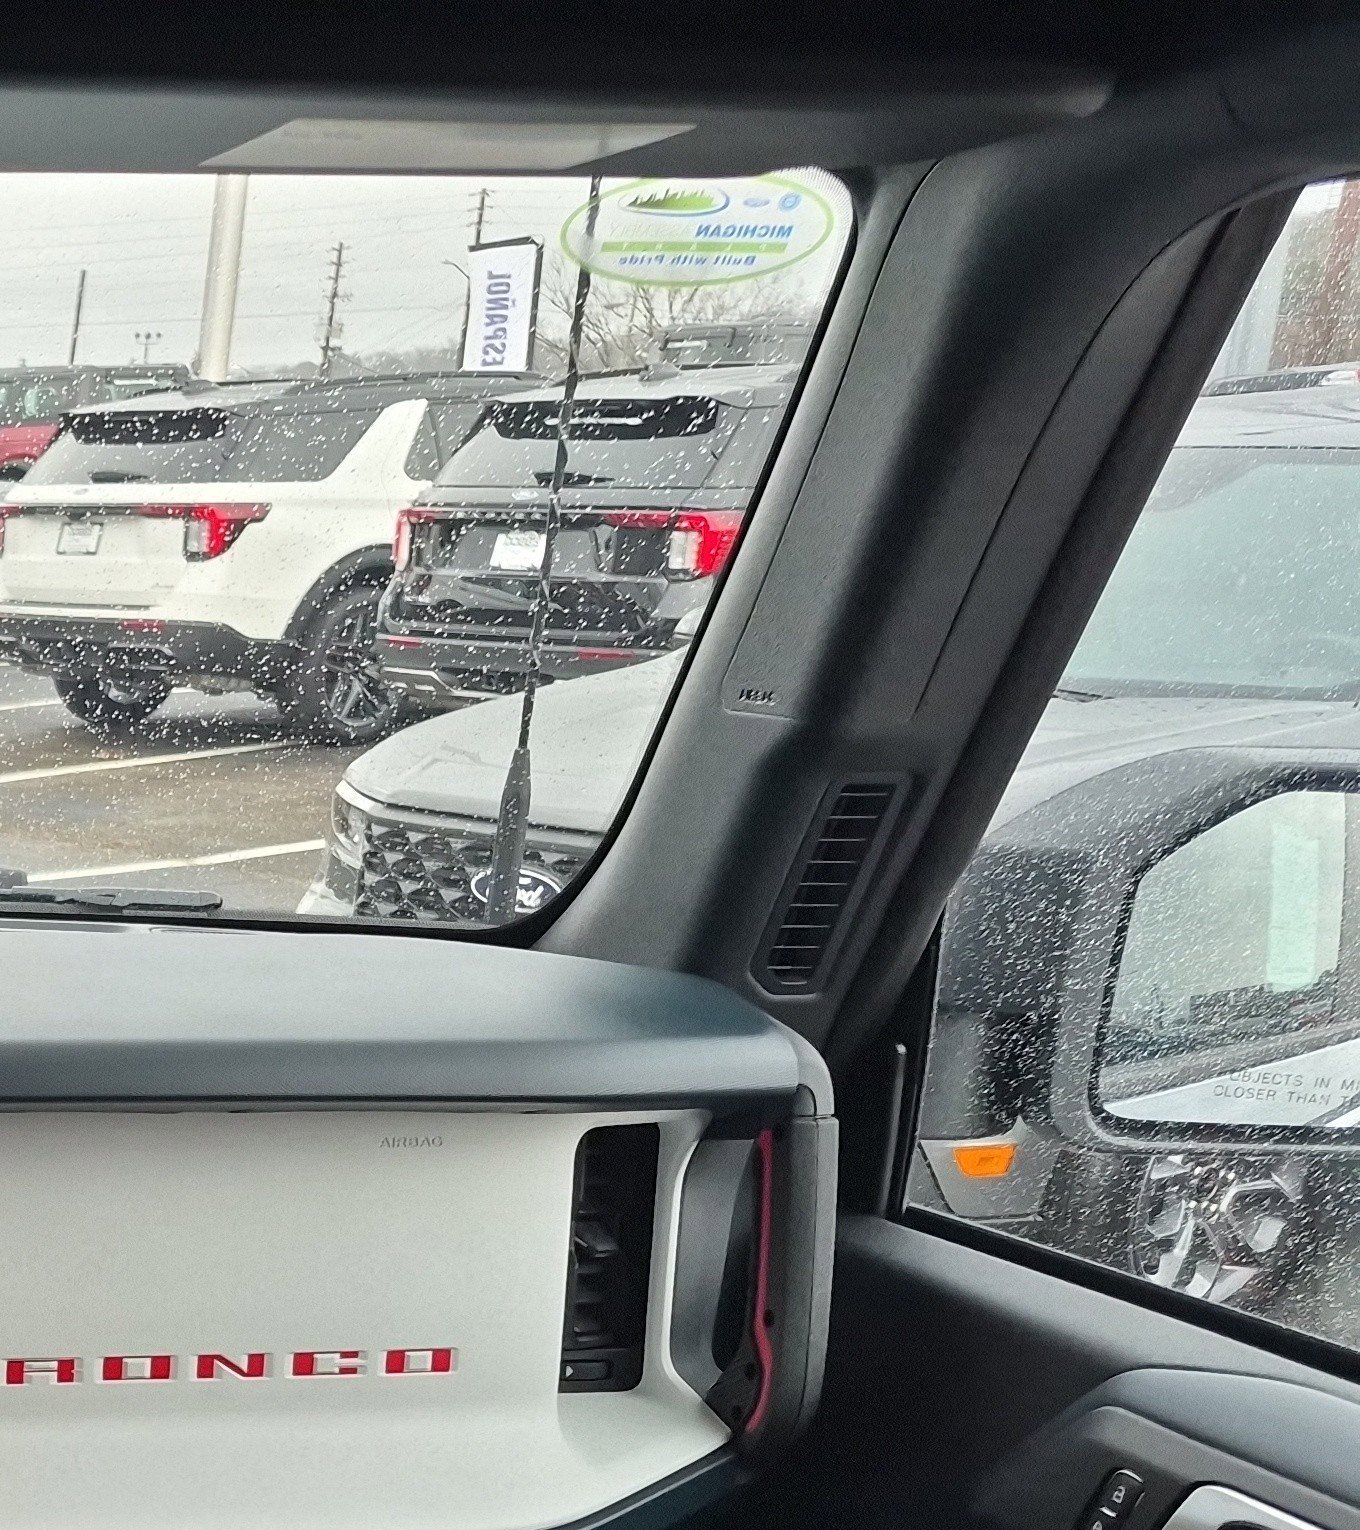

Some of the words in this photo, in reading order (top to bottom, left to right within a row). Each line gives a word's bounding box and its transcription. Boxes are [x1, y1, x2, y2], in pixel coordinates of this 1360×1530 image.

[1230, 1070, 1303, 1087] OBJECTS
[1314, 1077, 1330, 1088] IN
[1213, 1085, 1277, 1100] CLOSER
[1288, 1091, 1331, 1105] THAN
[380, 1135, 443, 1148] AIRBAG
